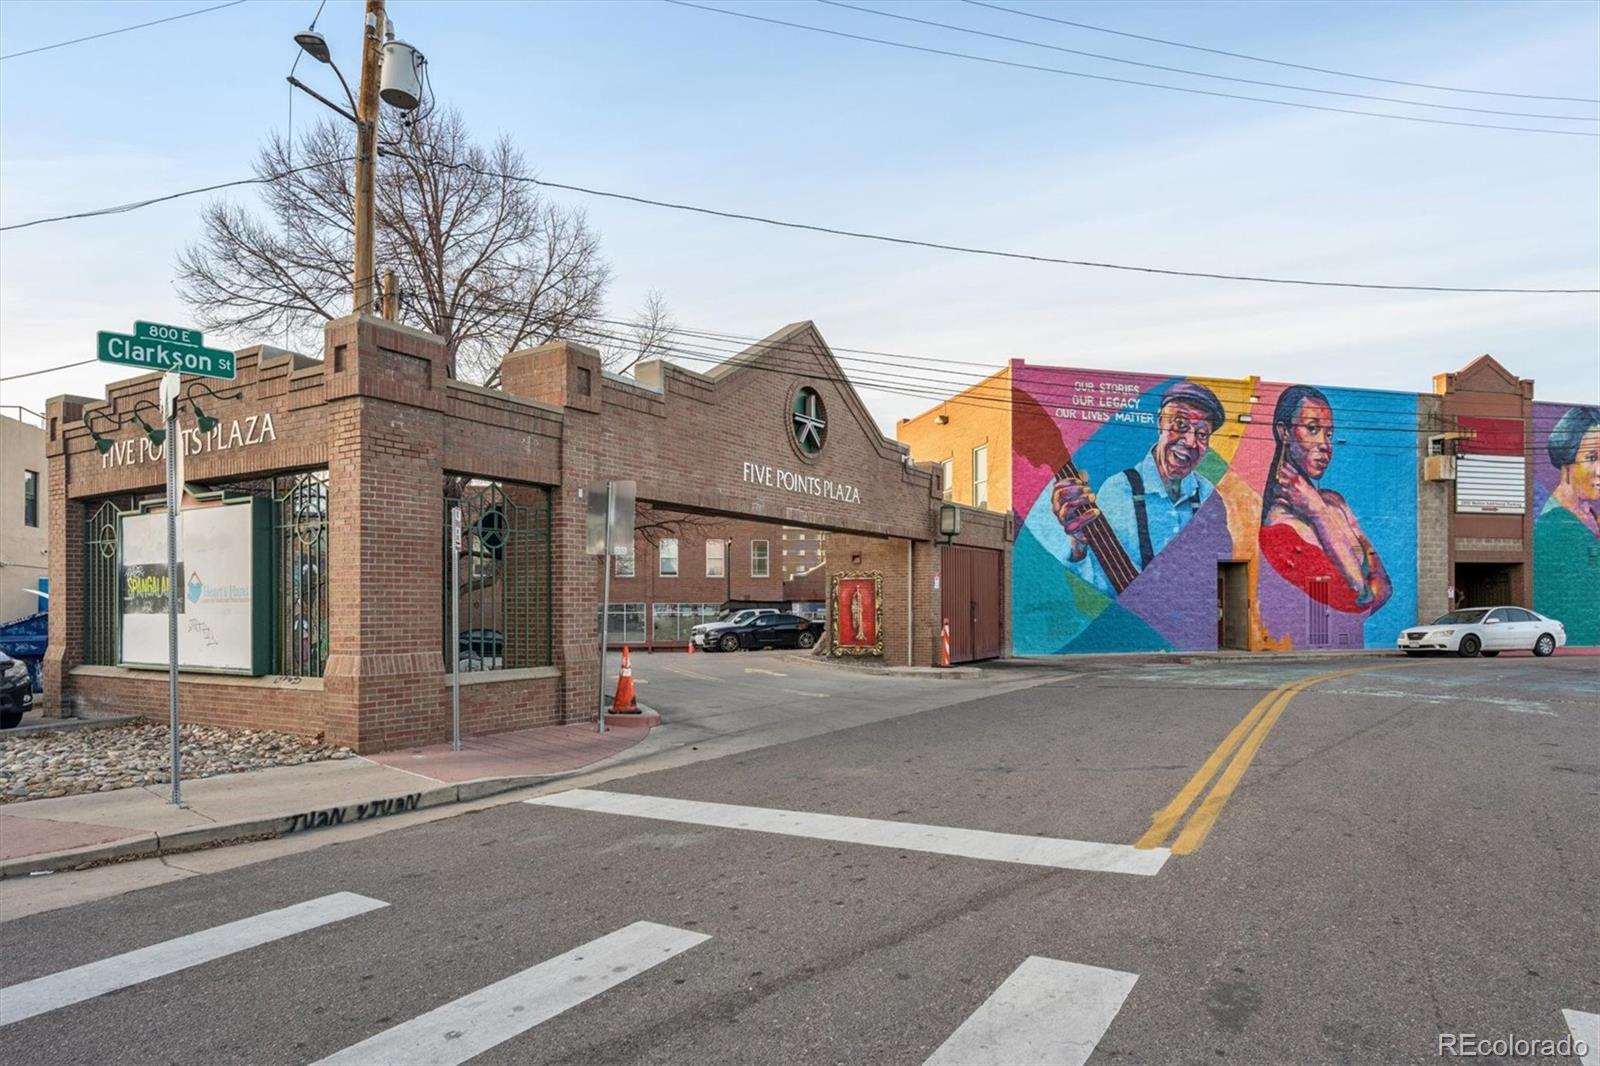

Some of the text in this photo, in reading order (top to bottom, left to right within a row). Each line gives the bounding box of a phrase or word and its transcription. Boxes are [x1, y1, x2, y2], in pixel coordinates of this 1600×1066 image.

[149, 325, 191, 343] 800 E
[108, 337, 232, 371] Clarkson St
[1074, 381, 1140, 395] OUR STORIES
[1071, 395, 1141, 409] OUR LEGACY
[1055, 408, 1155, 424] OUR LIVES MATTER
[140, 427, 203, 464] POITS
[206, 413, 277, 452] PLAZA
[743, 462, 861, 504] FIVE POINTS PLAZA
